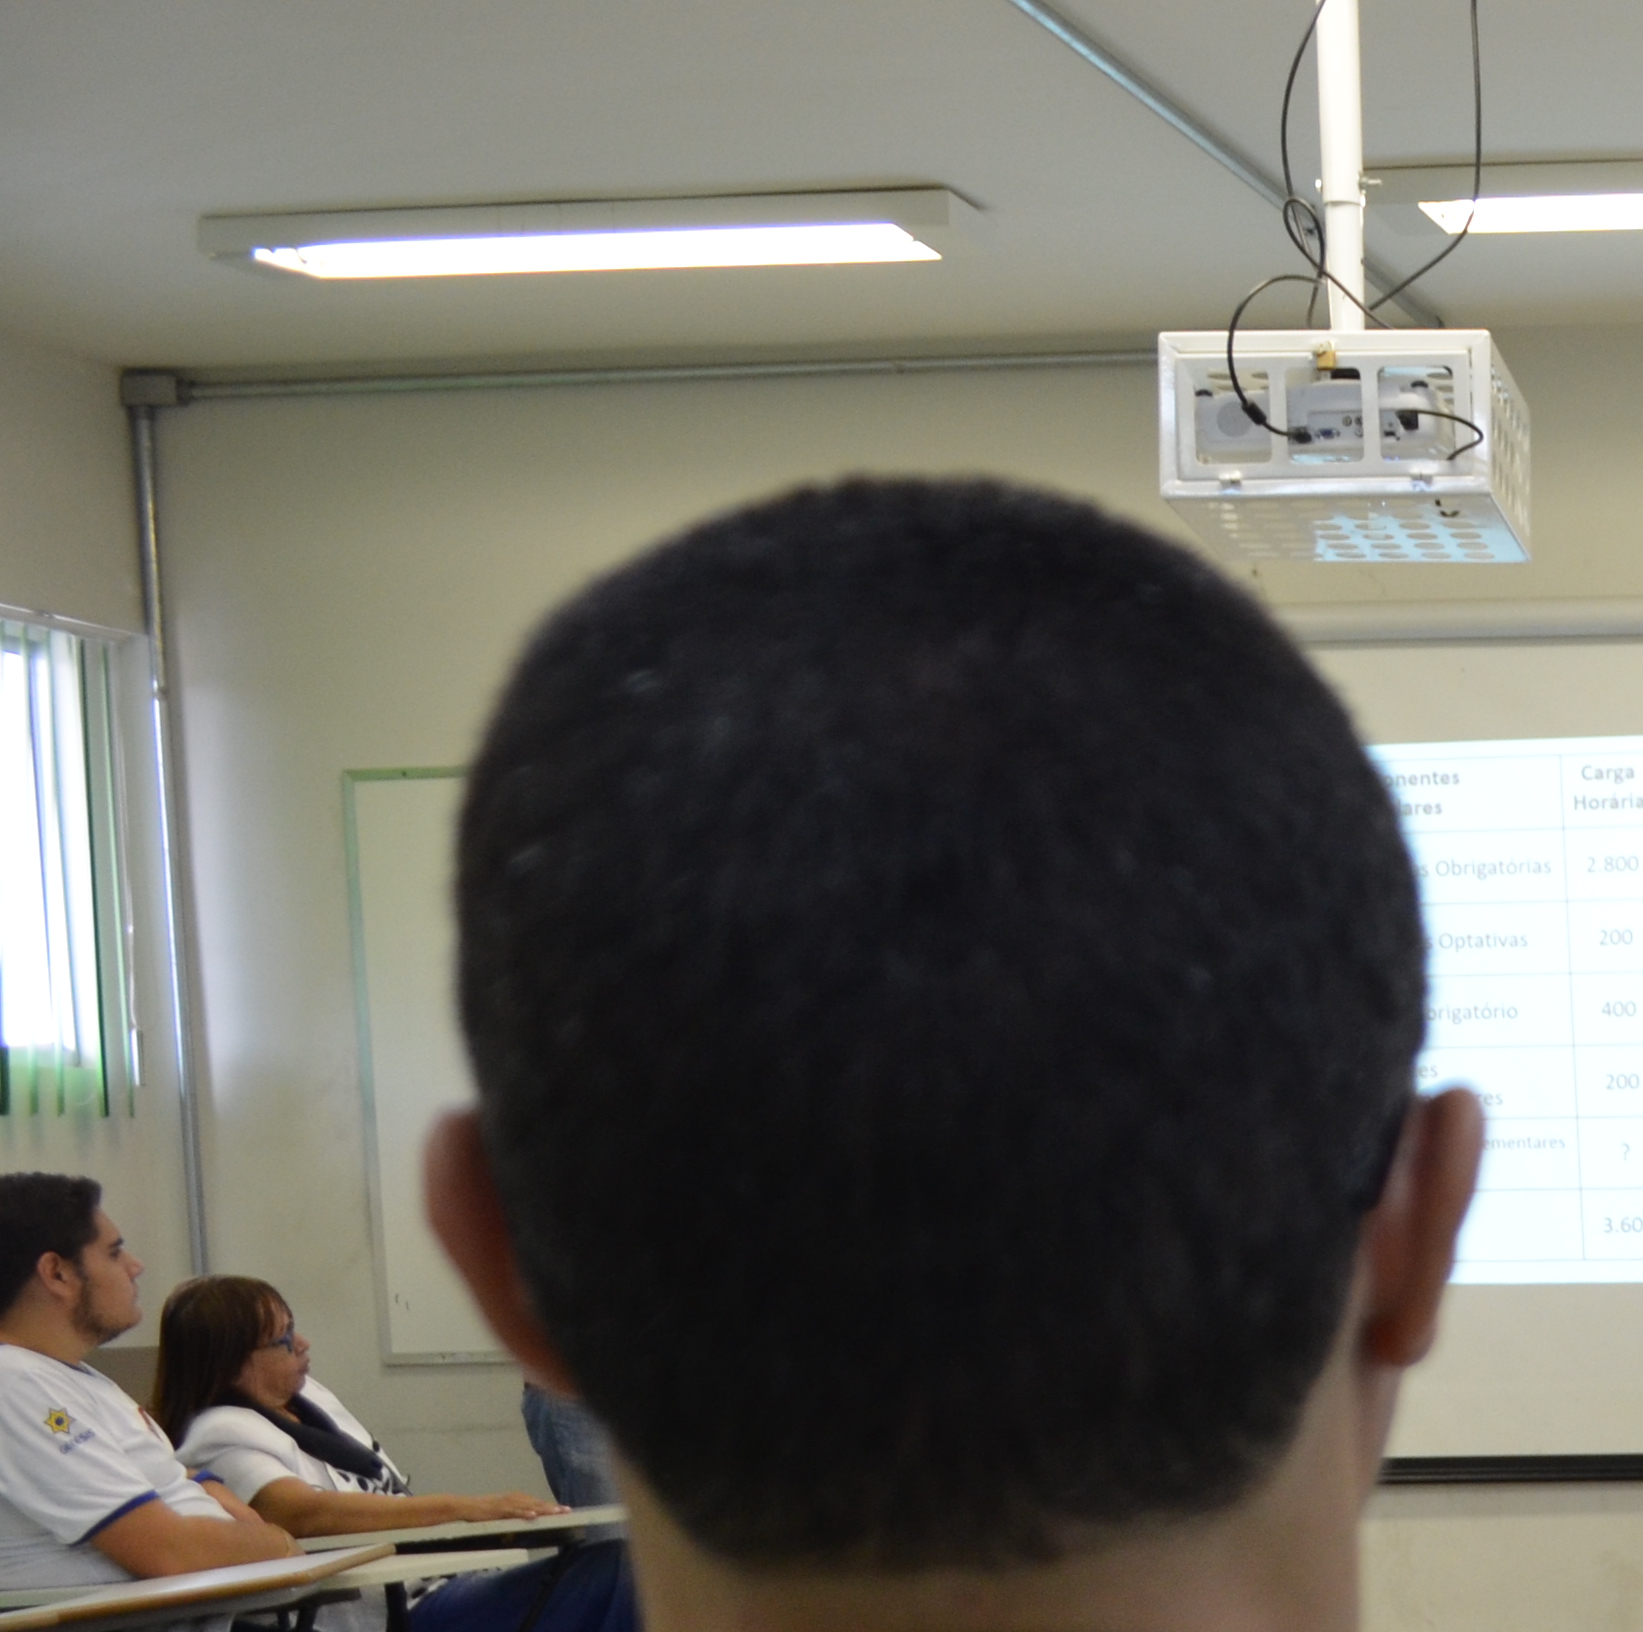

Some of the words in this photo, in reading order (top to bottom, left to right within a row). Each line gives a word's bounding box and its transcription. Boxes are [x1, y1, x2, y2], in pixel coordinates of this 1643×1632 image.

[1384, 771, 1460, 788] onentes
[1581, 764, 1636, 785] Carga
[1435, 857, 1553, 881] Obrigatórias
[1586, 854, 1640, 874] 2.800
[1438, 932, 1529, 952] Optativas
[1598, 927, 1634, 947] 200
[1428, 1002, 1519, 1025] brigatório
[1600, 999, 1638, 1018] 400
[1605, 1072, 1641, 1091] 200
[1485, 1135, 1567, 1151] ementares
[1620, 1141, 1632, 1162] ?
